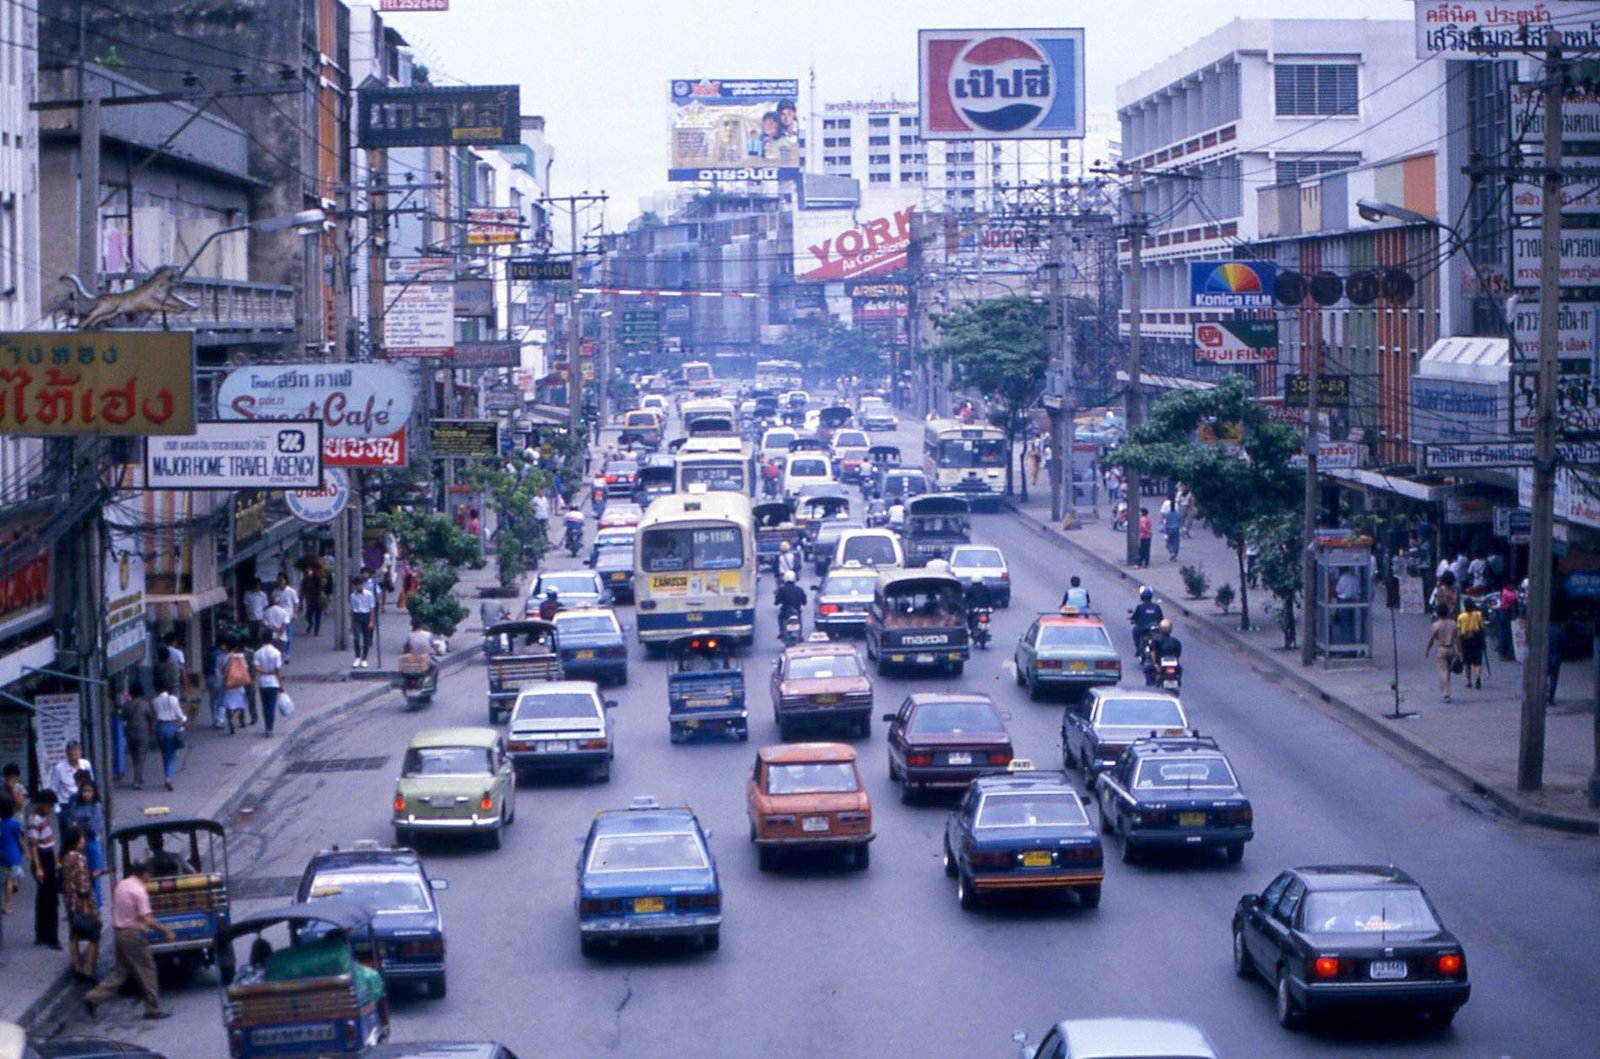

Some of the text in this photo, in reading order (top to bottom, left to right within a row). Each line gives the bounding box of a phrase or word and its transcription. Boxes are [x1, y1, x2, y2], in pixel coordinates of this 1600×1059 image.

[954, 64, 1050, 98] เป๊ปซี่
[808, 205, 917, 267] YORK
[1195, 293, 1272, 307] Konica FILM
[1195, 347, 1276, 361] FUJI FILM
[0, 366, 174, 425] ไท้เฮง
[323, 391, 393, 434] Café
[153, 456, 315, 477] MAJOR HOME TRAVEL AGENCY
